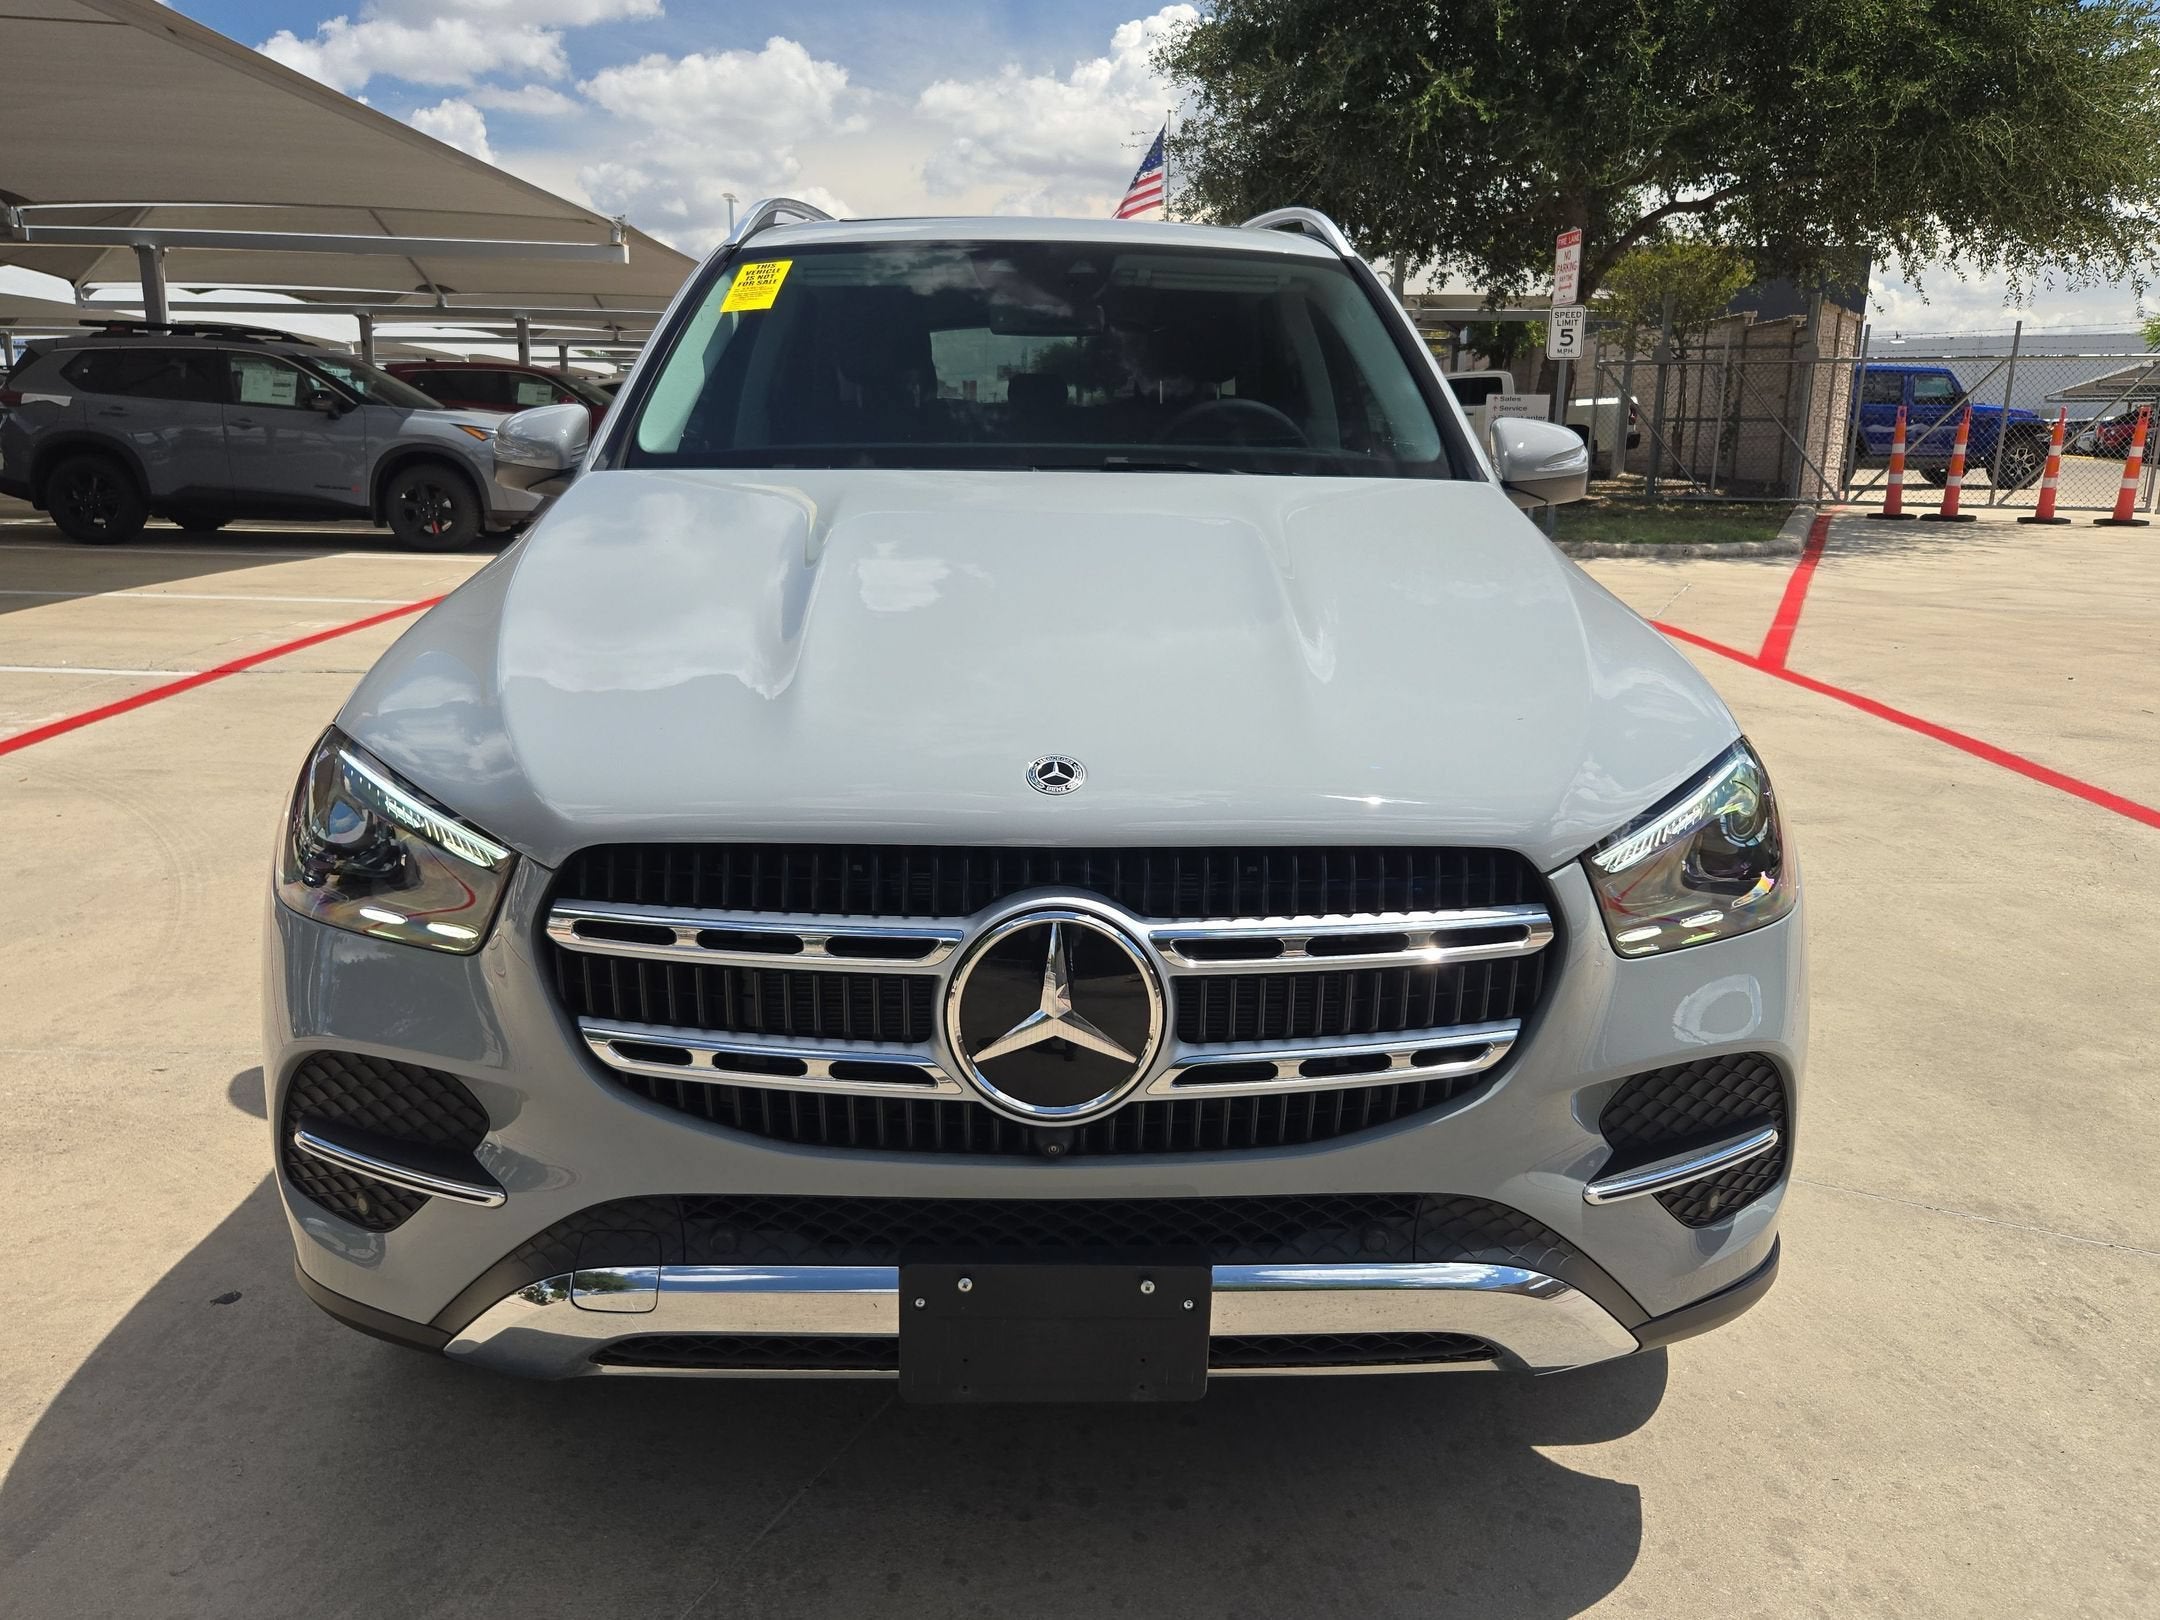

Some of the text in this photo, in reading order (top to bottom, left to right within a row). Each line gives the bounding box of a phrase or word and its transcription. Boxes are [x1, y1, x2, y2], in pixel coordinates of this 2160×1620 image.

[1564, 250, 1572, 260] NO
[745, 268, 781, 276] VEHICLE
[1557, 261, 1578, 274] PARKING
[1554, 311, 1582, 319] SPEED
[1560, 328, 1574, 346] 5
